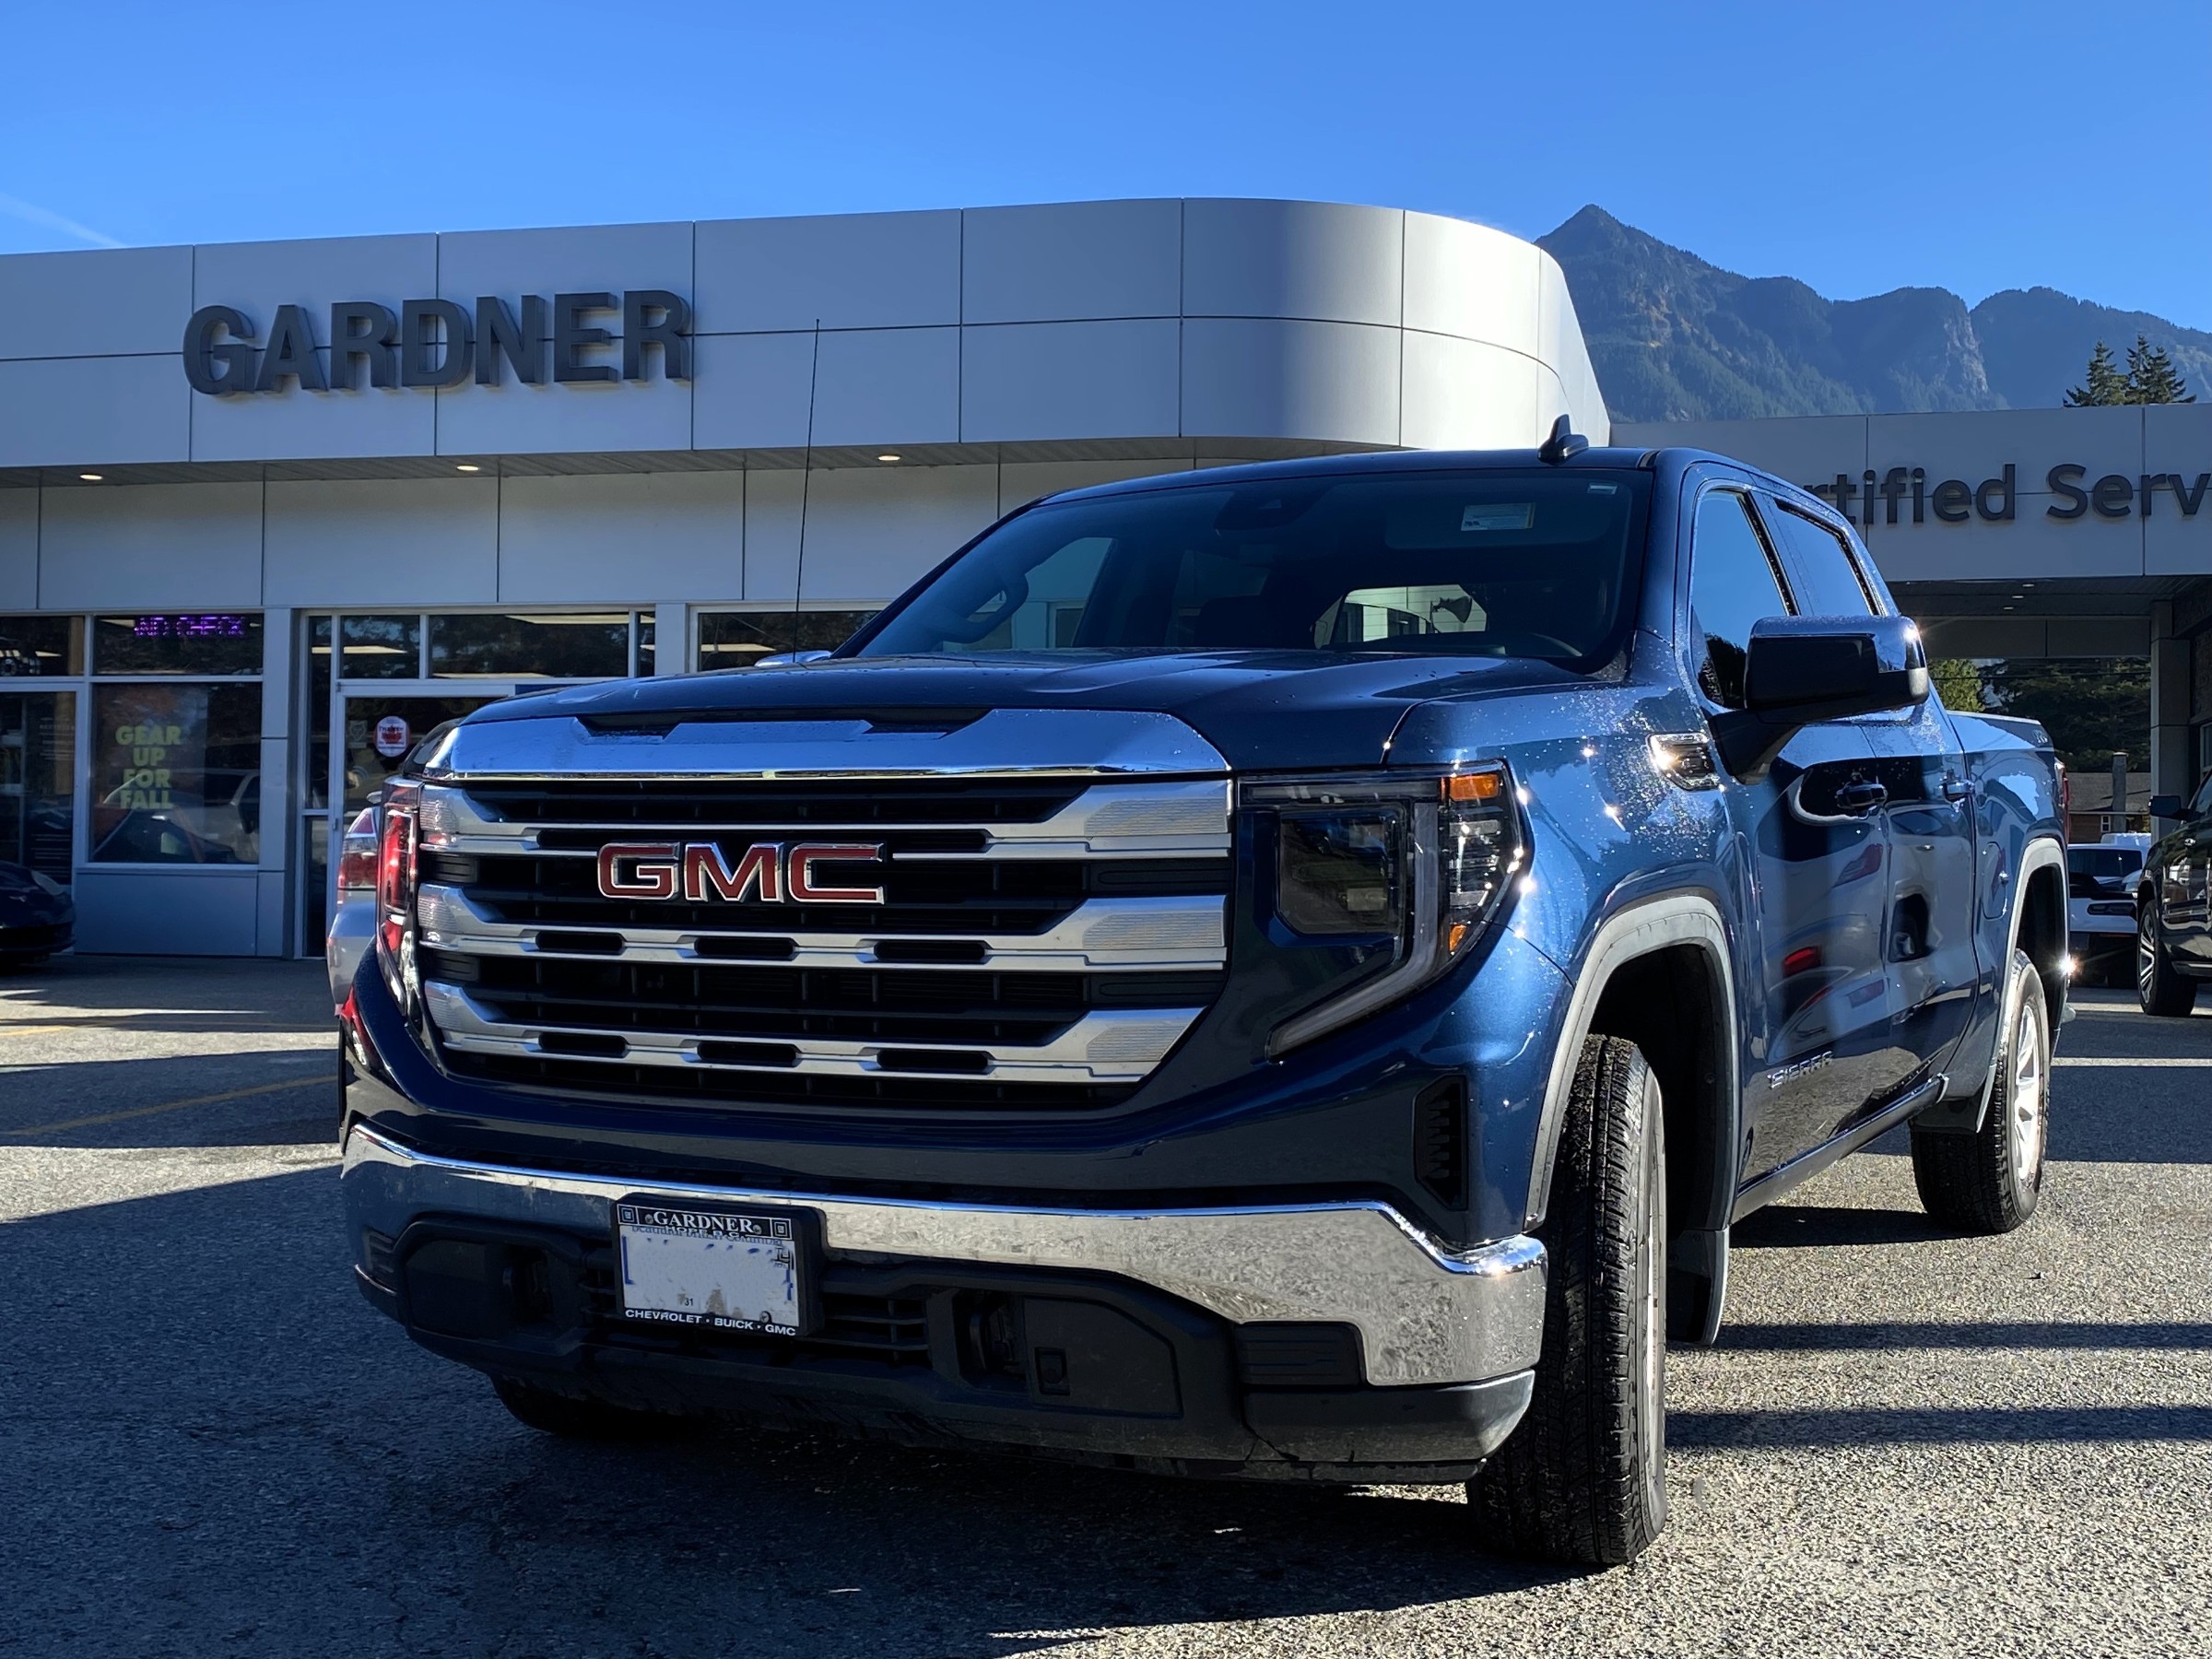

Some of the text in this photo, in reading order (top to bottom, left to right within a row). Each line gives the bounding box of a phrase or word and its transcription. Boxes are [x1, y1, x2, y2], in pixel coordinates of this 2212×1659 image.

[183, 289, 693, 396] GARDNER
[115, 725, 182, 745] GEAR
[133, 747, 166, 766] UP
[124, 768, 171, 788] FOR
[120, 790, 173, 809] FALL
[597, 841, 885, 904] GMC
[653, 1211, 754, 1233] GARDNER
[684, 1298, 694, 1307] 31
[625, 1309, 796, 1336] CHEVROLET BUICK GMC
